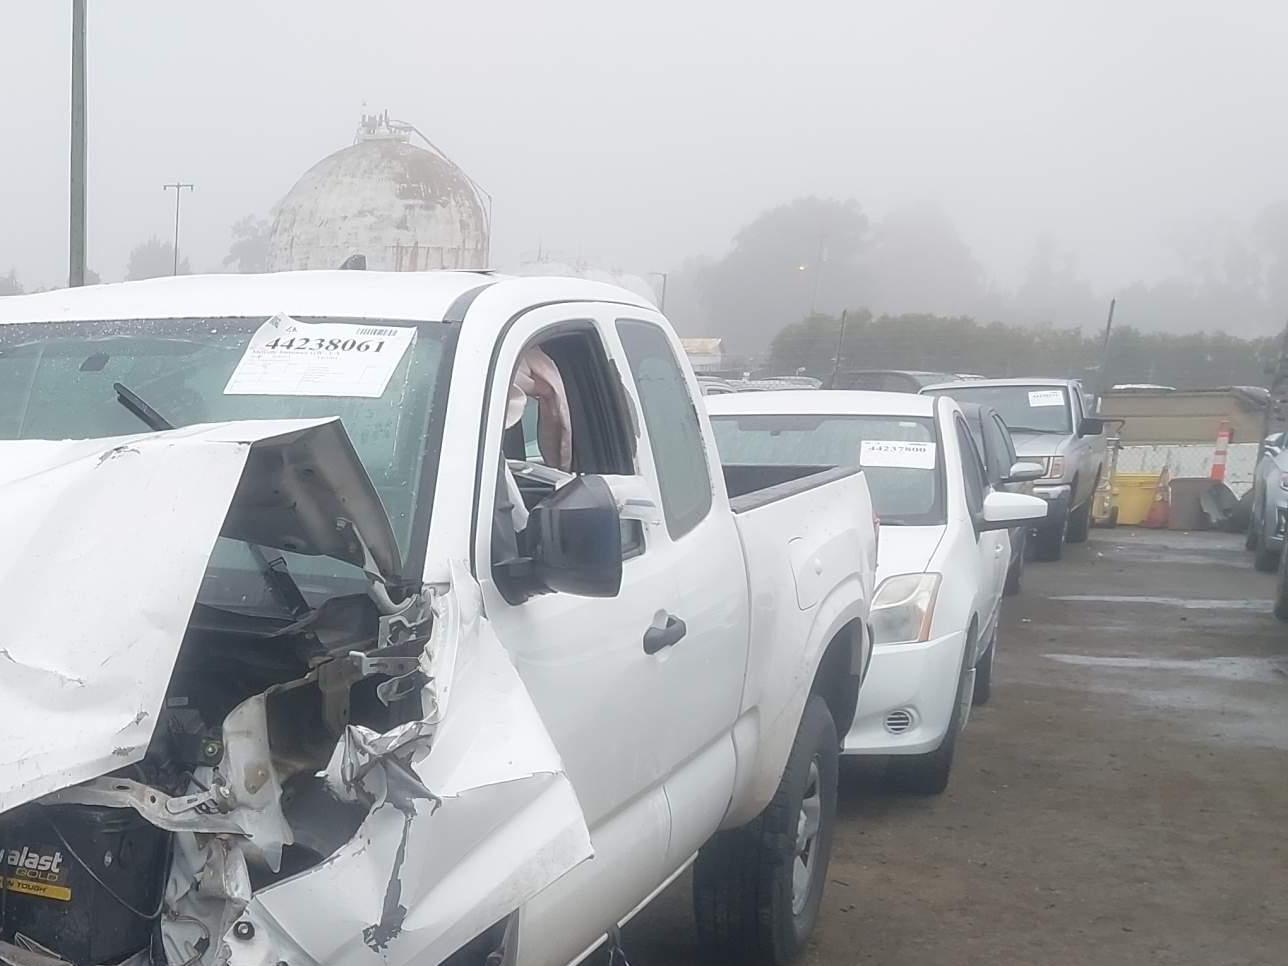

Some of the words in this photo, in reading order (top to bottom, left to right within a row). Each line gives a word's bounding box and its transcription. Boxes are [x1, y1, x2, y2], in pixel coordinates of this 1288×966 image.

[265, 336, 385, 353] 44238061
[15, 867, 59, 882] GOLD
[16, 881, 48, 894] TOUGH
